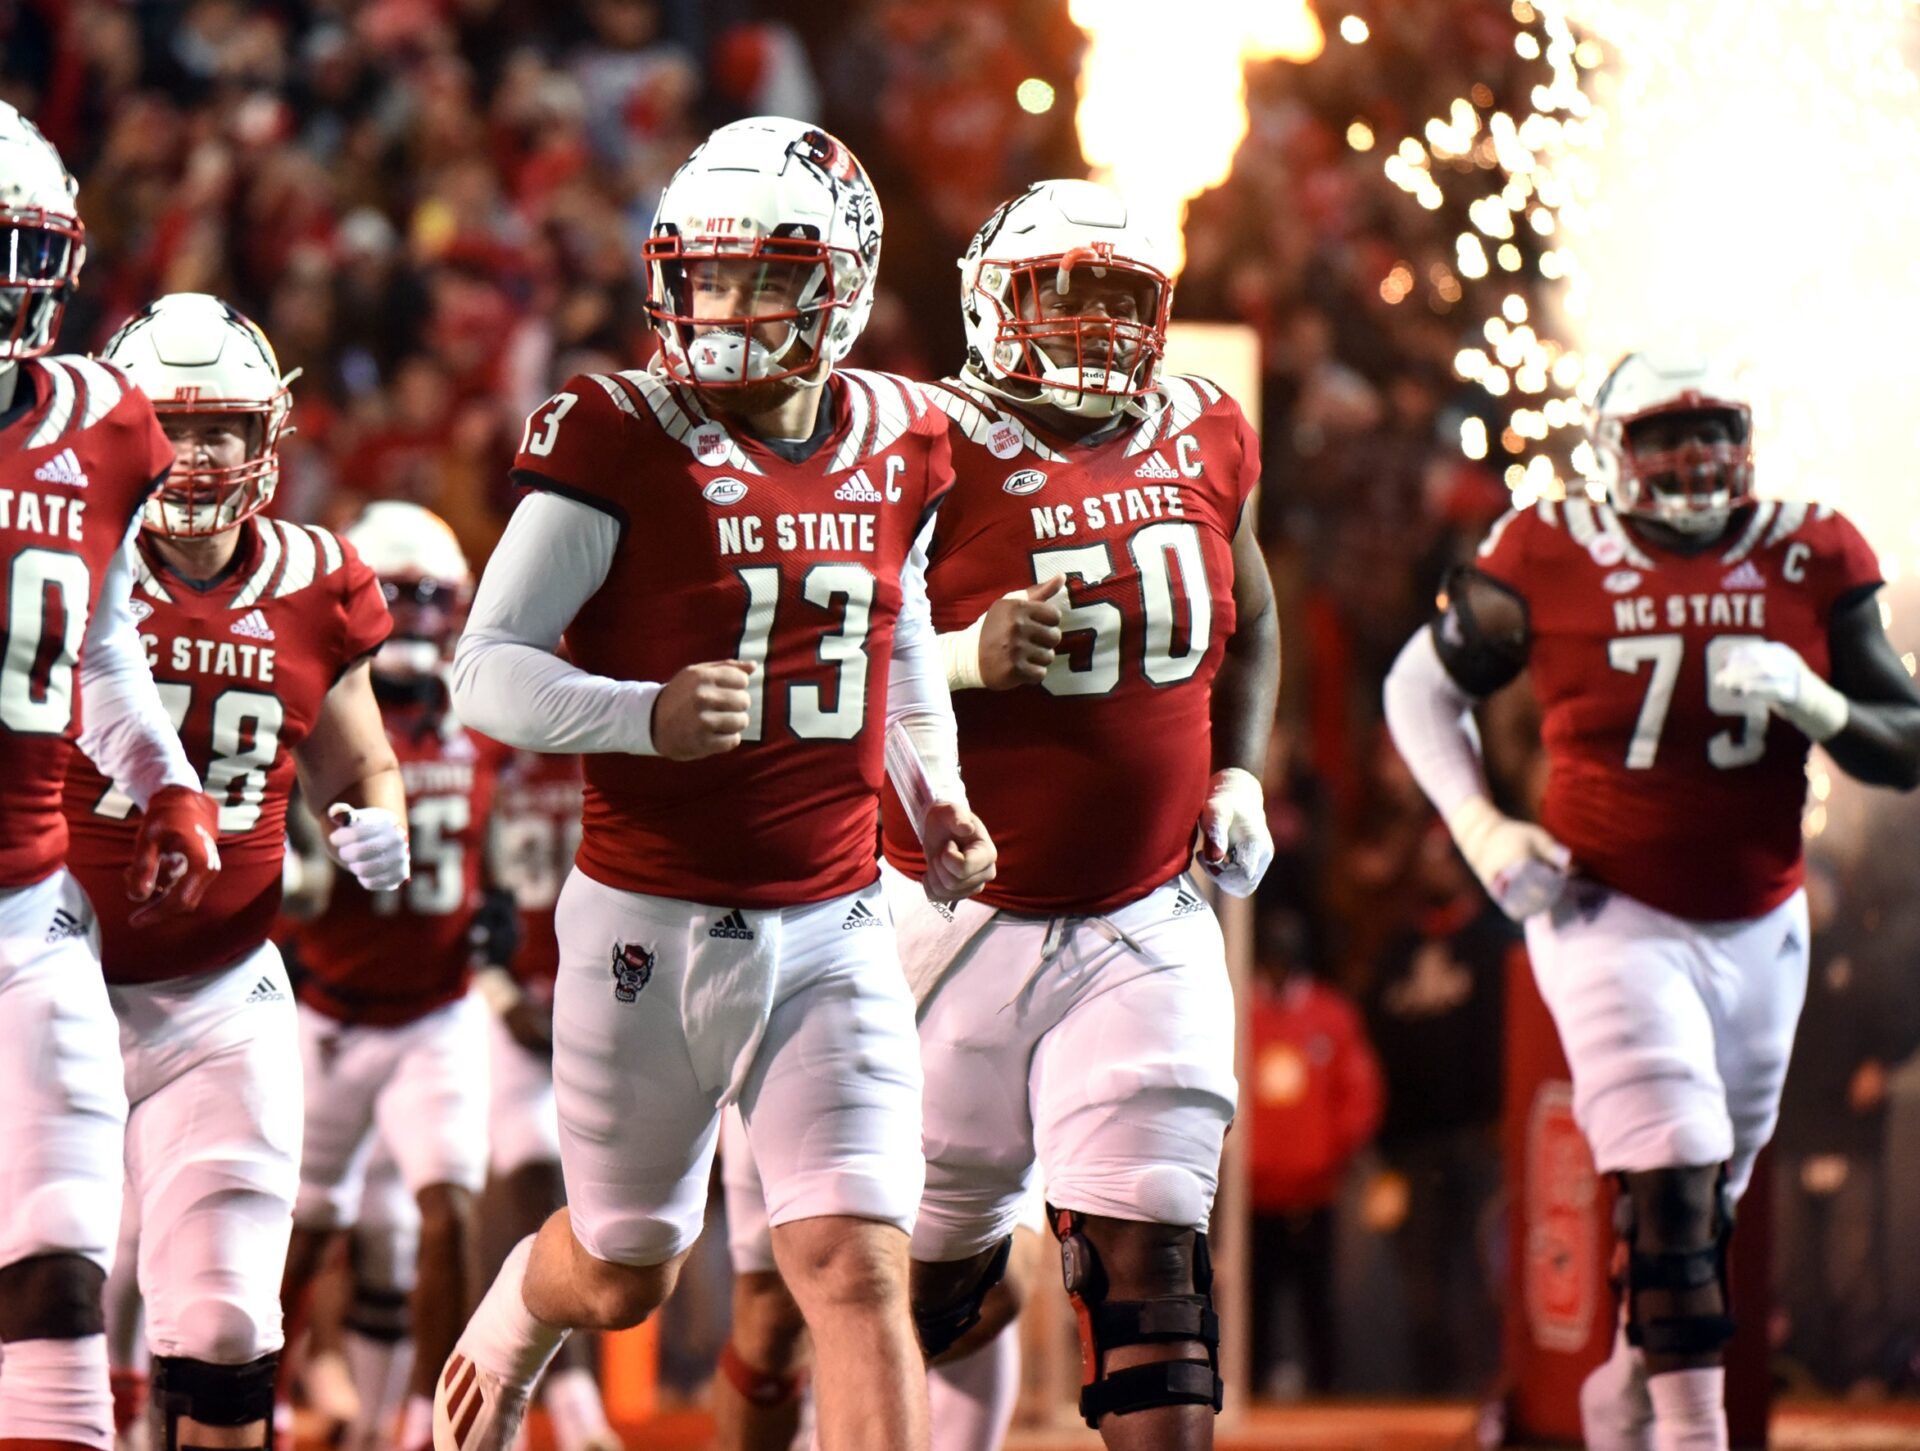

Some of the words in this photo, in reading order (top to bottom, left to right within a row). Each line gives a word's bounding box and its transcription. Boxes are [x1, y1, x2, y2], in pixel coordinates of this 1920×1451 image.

[706, 217, 735, 233] HTT
[697, 444, 726, 456] UNITED
[994, 435, 1020, 454] UNITED
[1175, 434, 1203, 478] C
[886, 455, 905, 503] C
[1012, 473, 1038, 488] ACC
[1134, 468, 1179, 479] adidas
[711, 485, 740, 496] ACC
[834, 488, 883, 502] adidas
[0, 488, 87, 542] TATE
[1030, 504, 1076, 540] NC
[1082, 485, 1185, 531] STATE
[717, 514, 764, 555] NC
[775, 513, 876, 552] STATE
[1782, 542, 1811, 583] C
[1032, 521, 1213, 697] 50
[1613, 597, 1657, 631] NC
[1665, 594, 1766, 628] STATE
[139, 633, 160, 668] C
[171, 636, 276, 683] STATE
[737, 563, 876, 741] 13
[842, 916, 884, 931] adidas
[930, 900, 956, 924] didas
[709, 927, 754, 940] adidas
